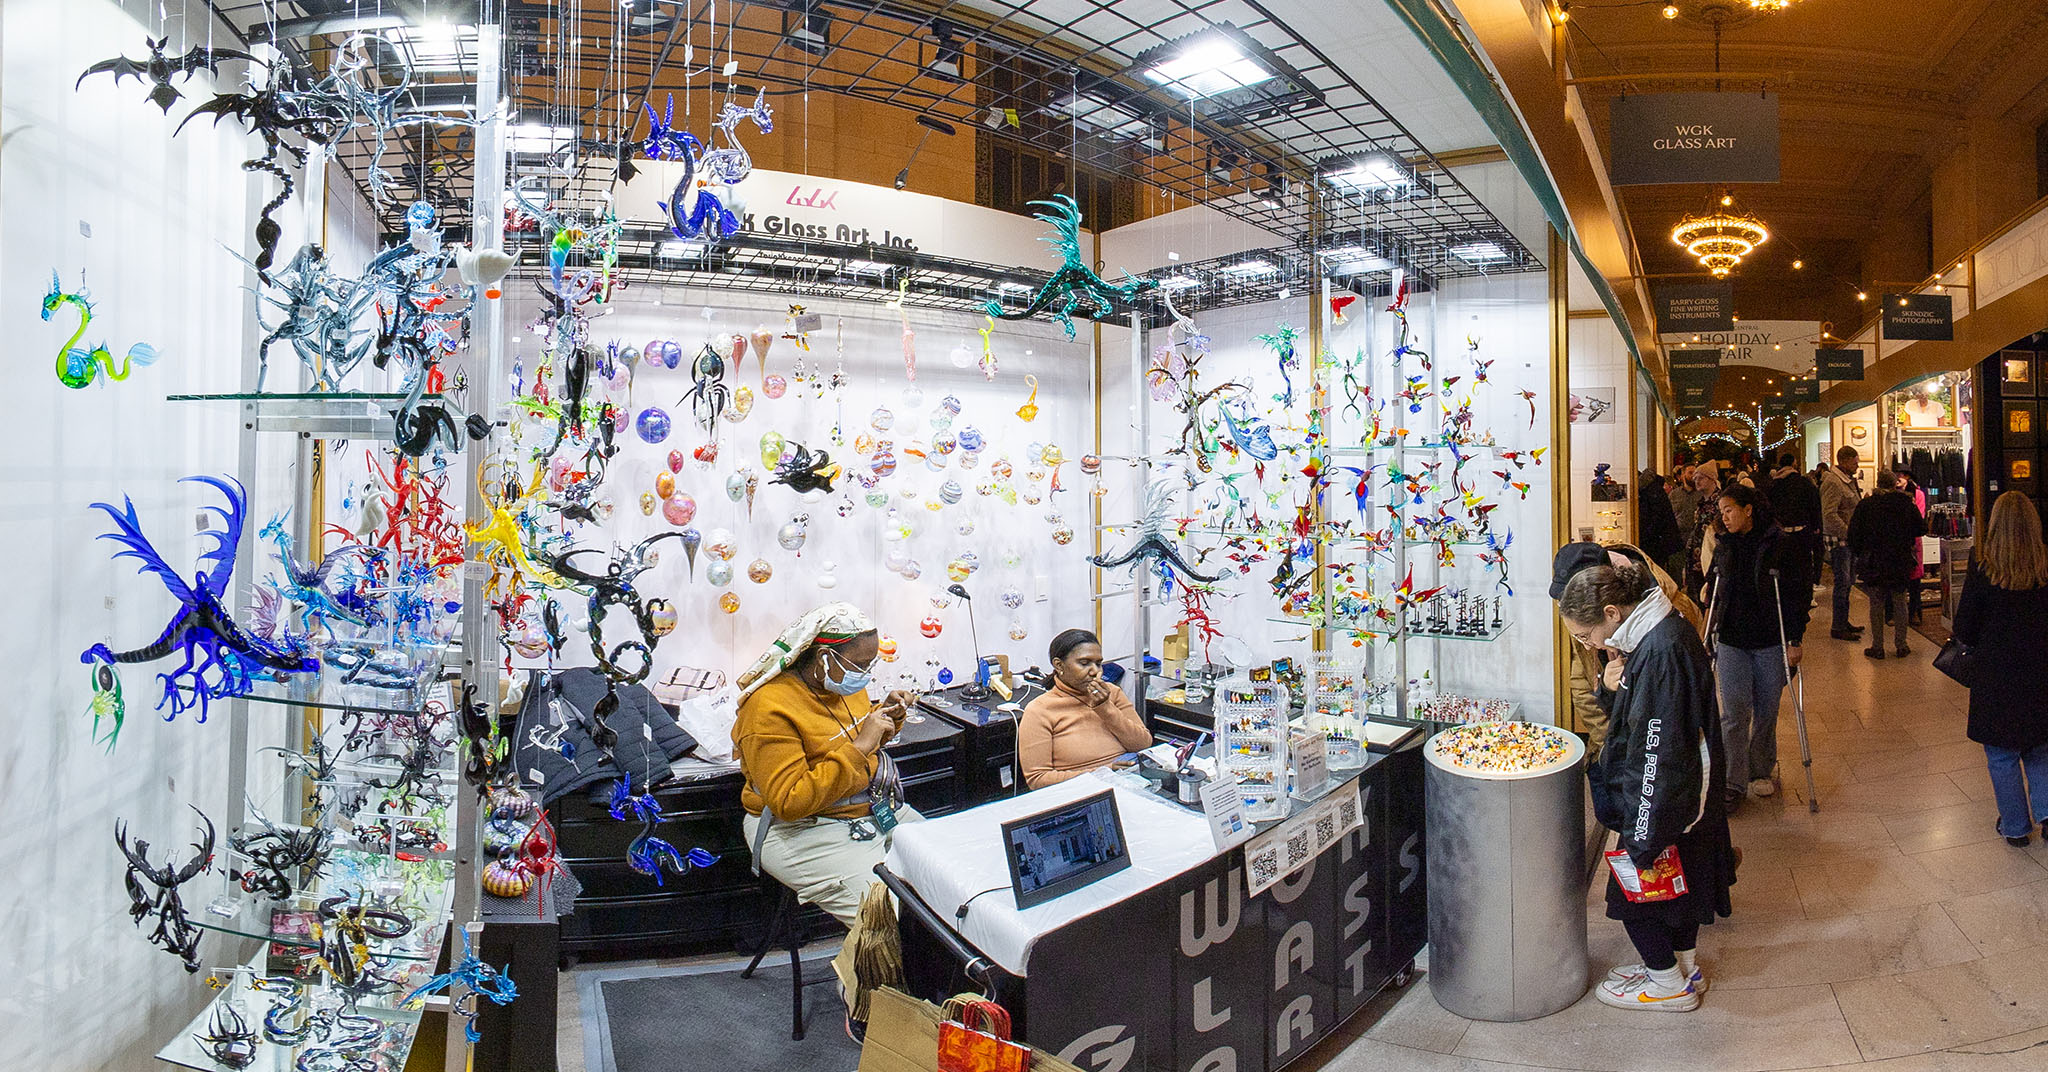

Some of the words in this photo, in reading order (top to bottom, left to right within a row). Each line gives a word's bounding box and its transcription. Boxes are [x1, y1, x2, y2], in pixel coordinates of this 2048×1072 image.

[1675, 125, 1713, 136] WGK
[1653, 138, 1702, 150] GLASS
[1705, 138, 1737, 149] ART
[764, 216, 828, 239] Glass
[1699, 333, 1772, 345] HOLIDAY
[1720, 347, 1752, 359] FAIR
[1645, 719, 1662, 750] U.S.
[1641, 754, 1658, 796] POLO
[1634, 796, 1651, 841] ASSN.
